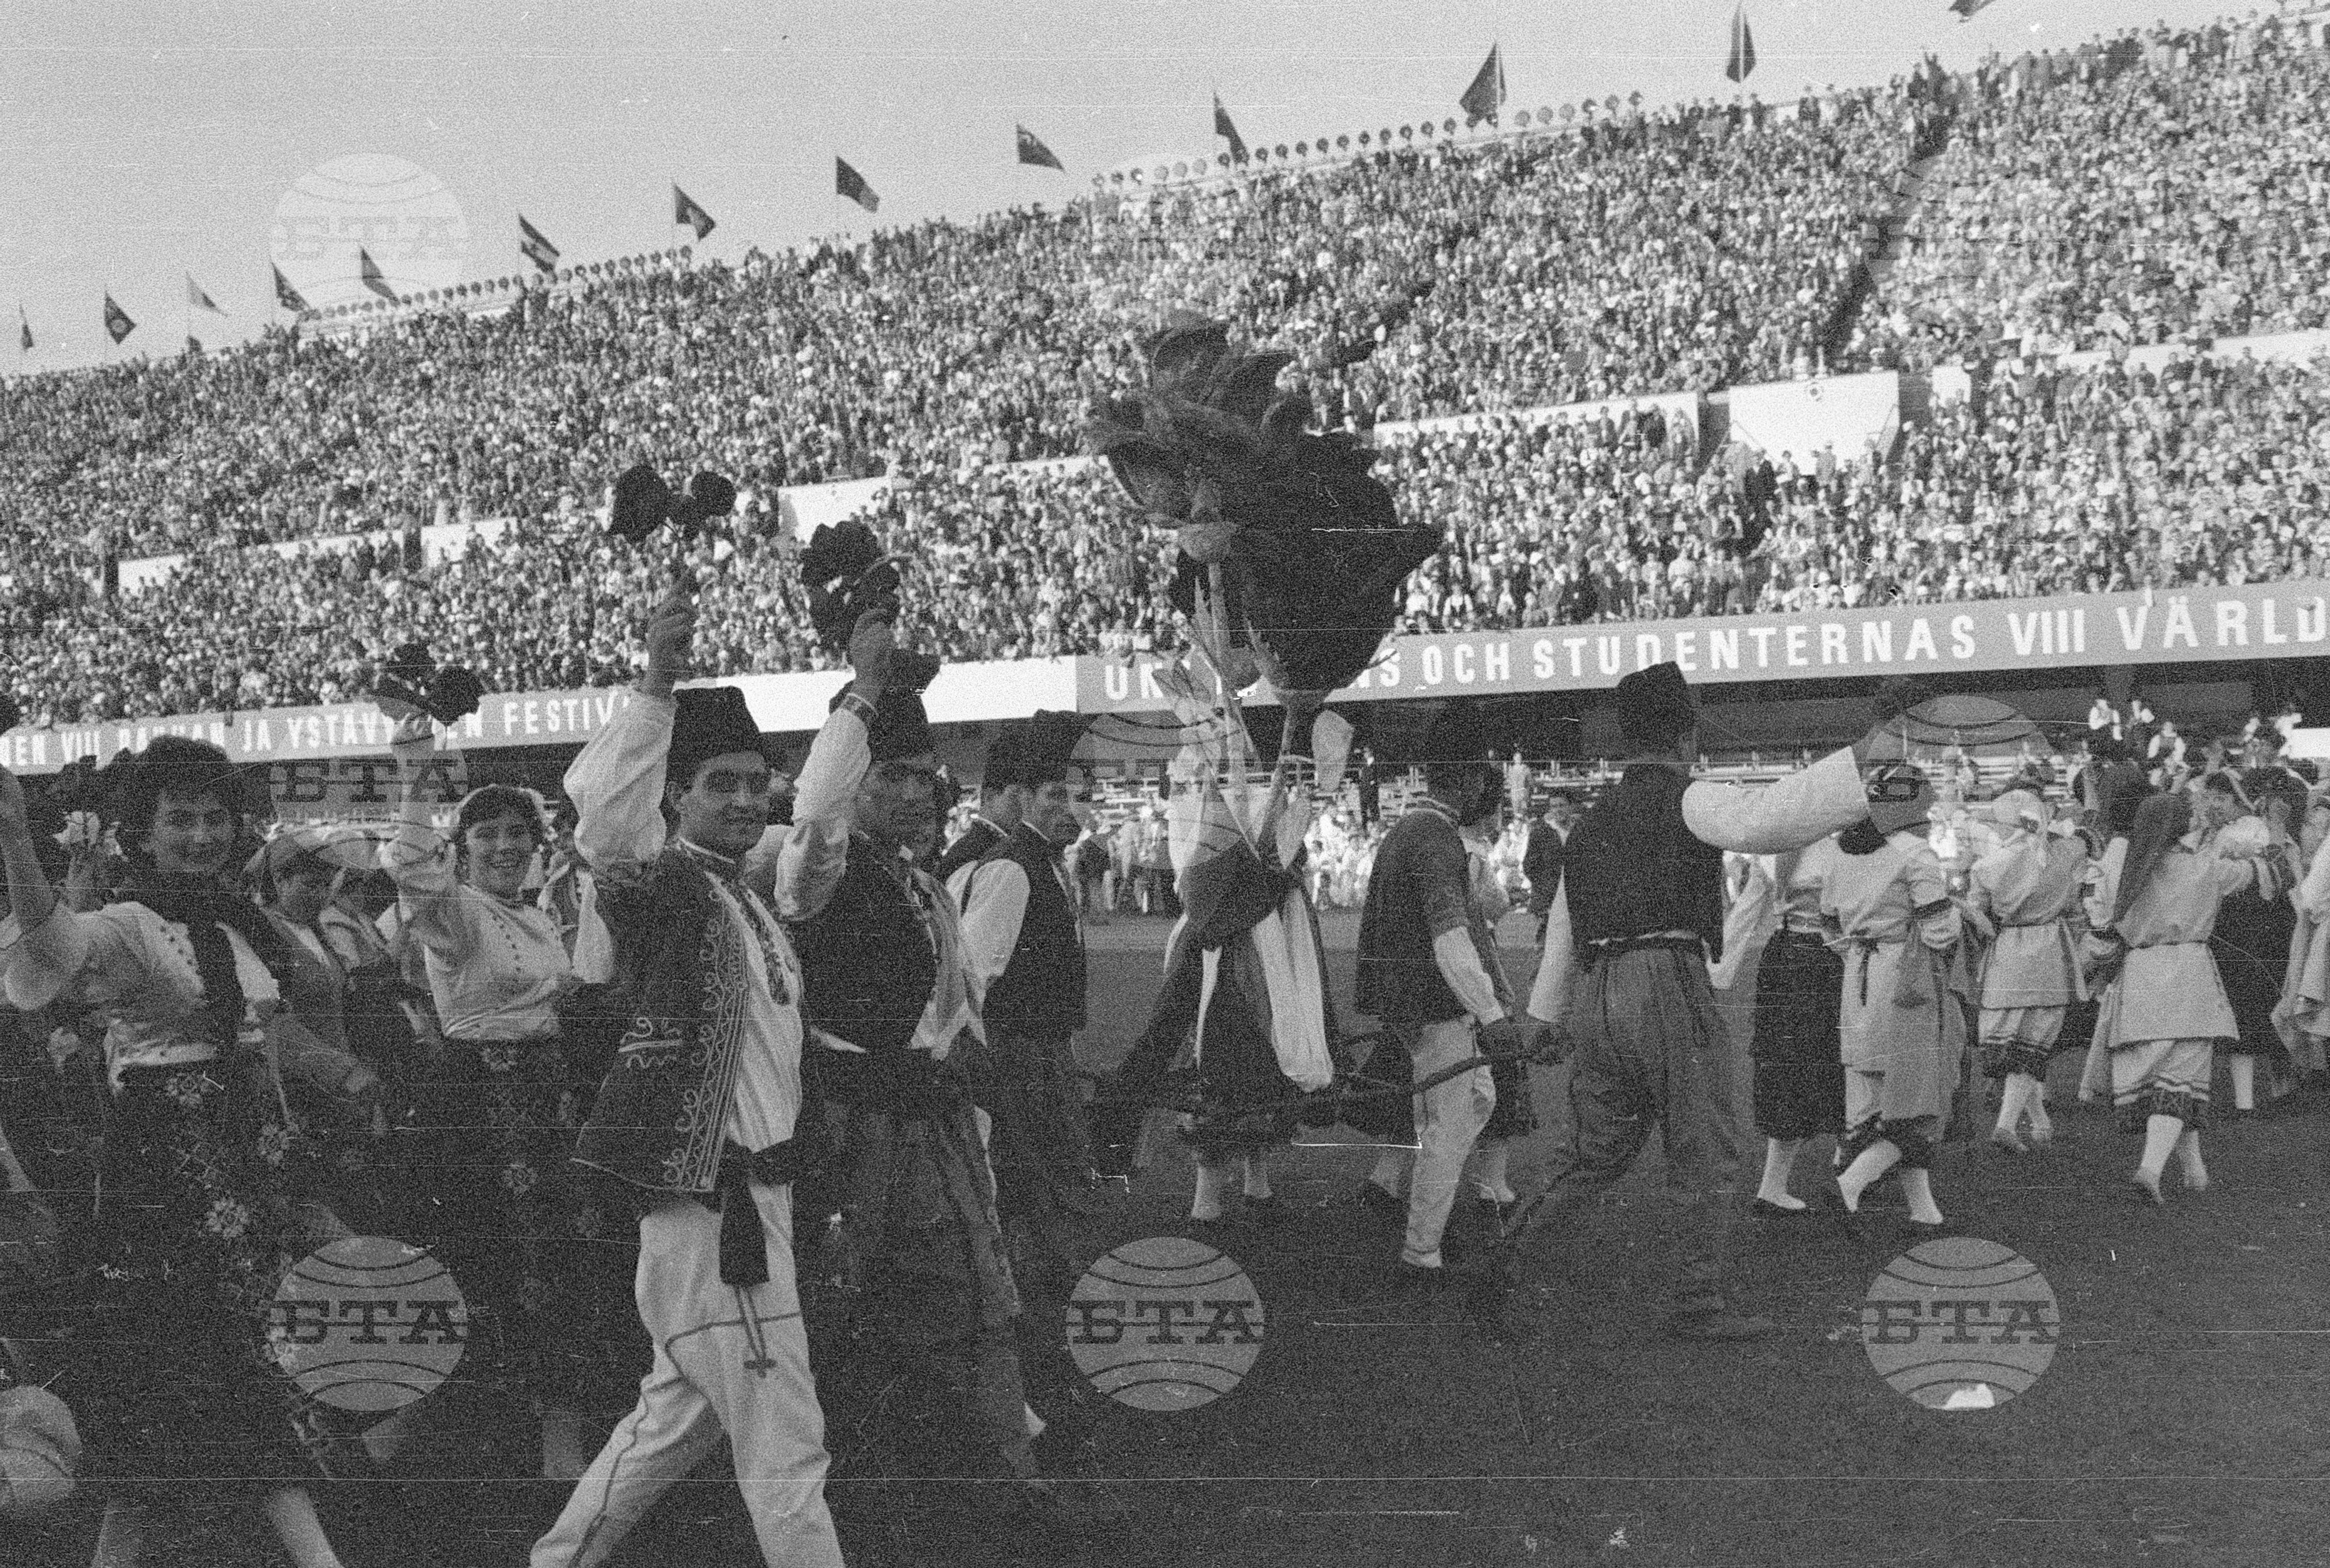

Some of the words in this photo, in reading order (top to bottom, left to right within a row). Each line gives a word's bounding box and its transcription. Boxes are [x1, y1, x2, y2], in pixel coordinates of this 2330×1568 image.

[1422, 641, 1510, 686] OCH
[1532, 615, 1976, 679] STUDENTERNAS
[2007, 608, 2085, 656] VIII
[2116, 595, 2327, 651] VÄRLD
[243, 719, 271, 751] JA
[504, 690, 630, 735] FESTIV
